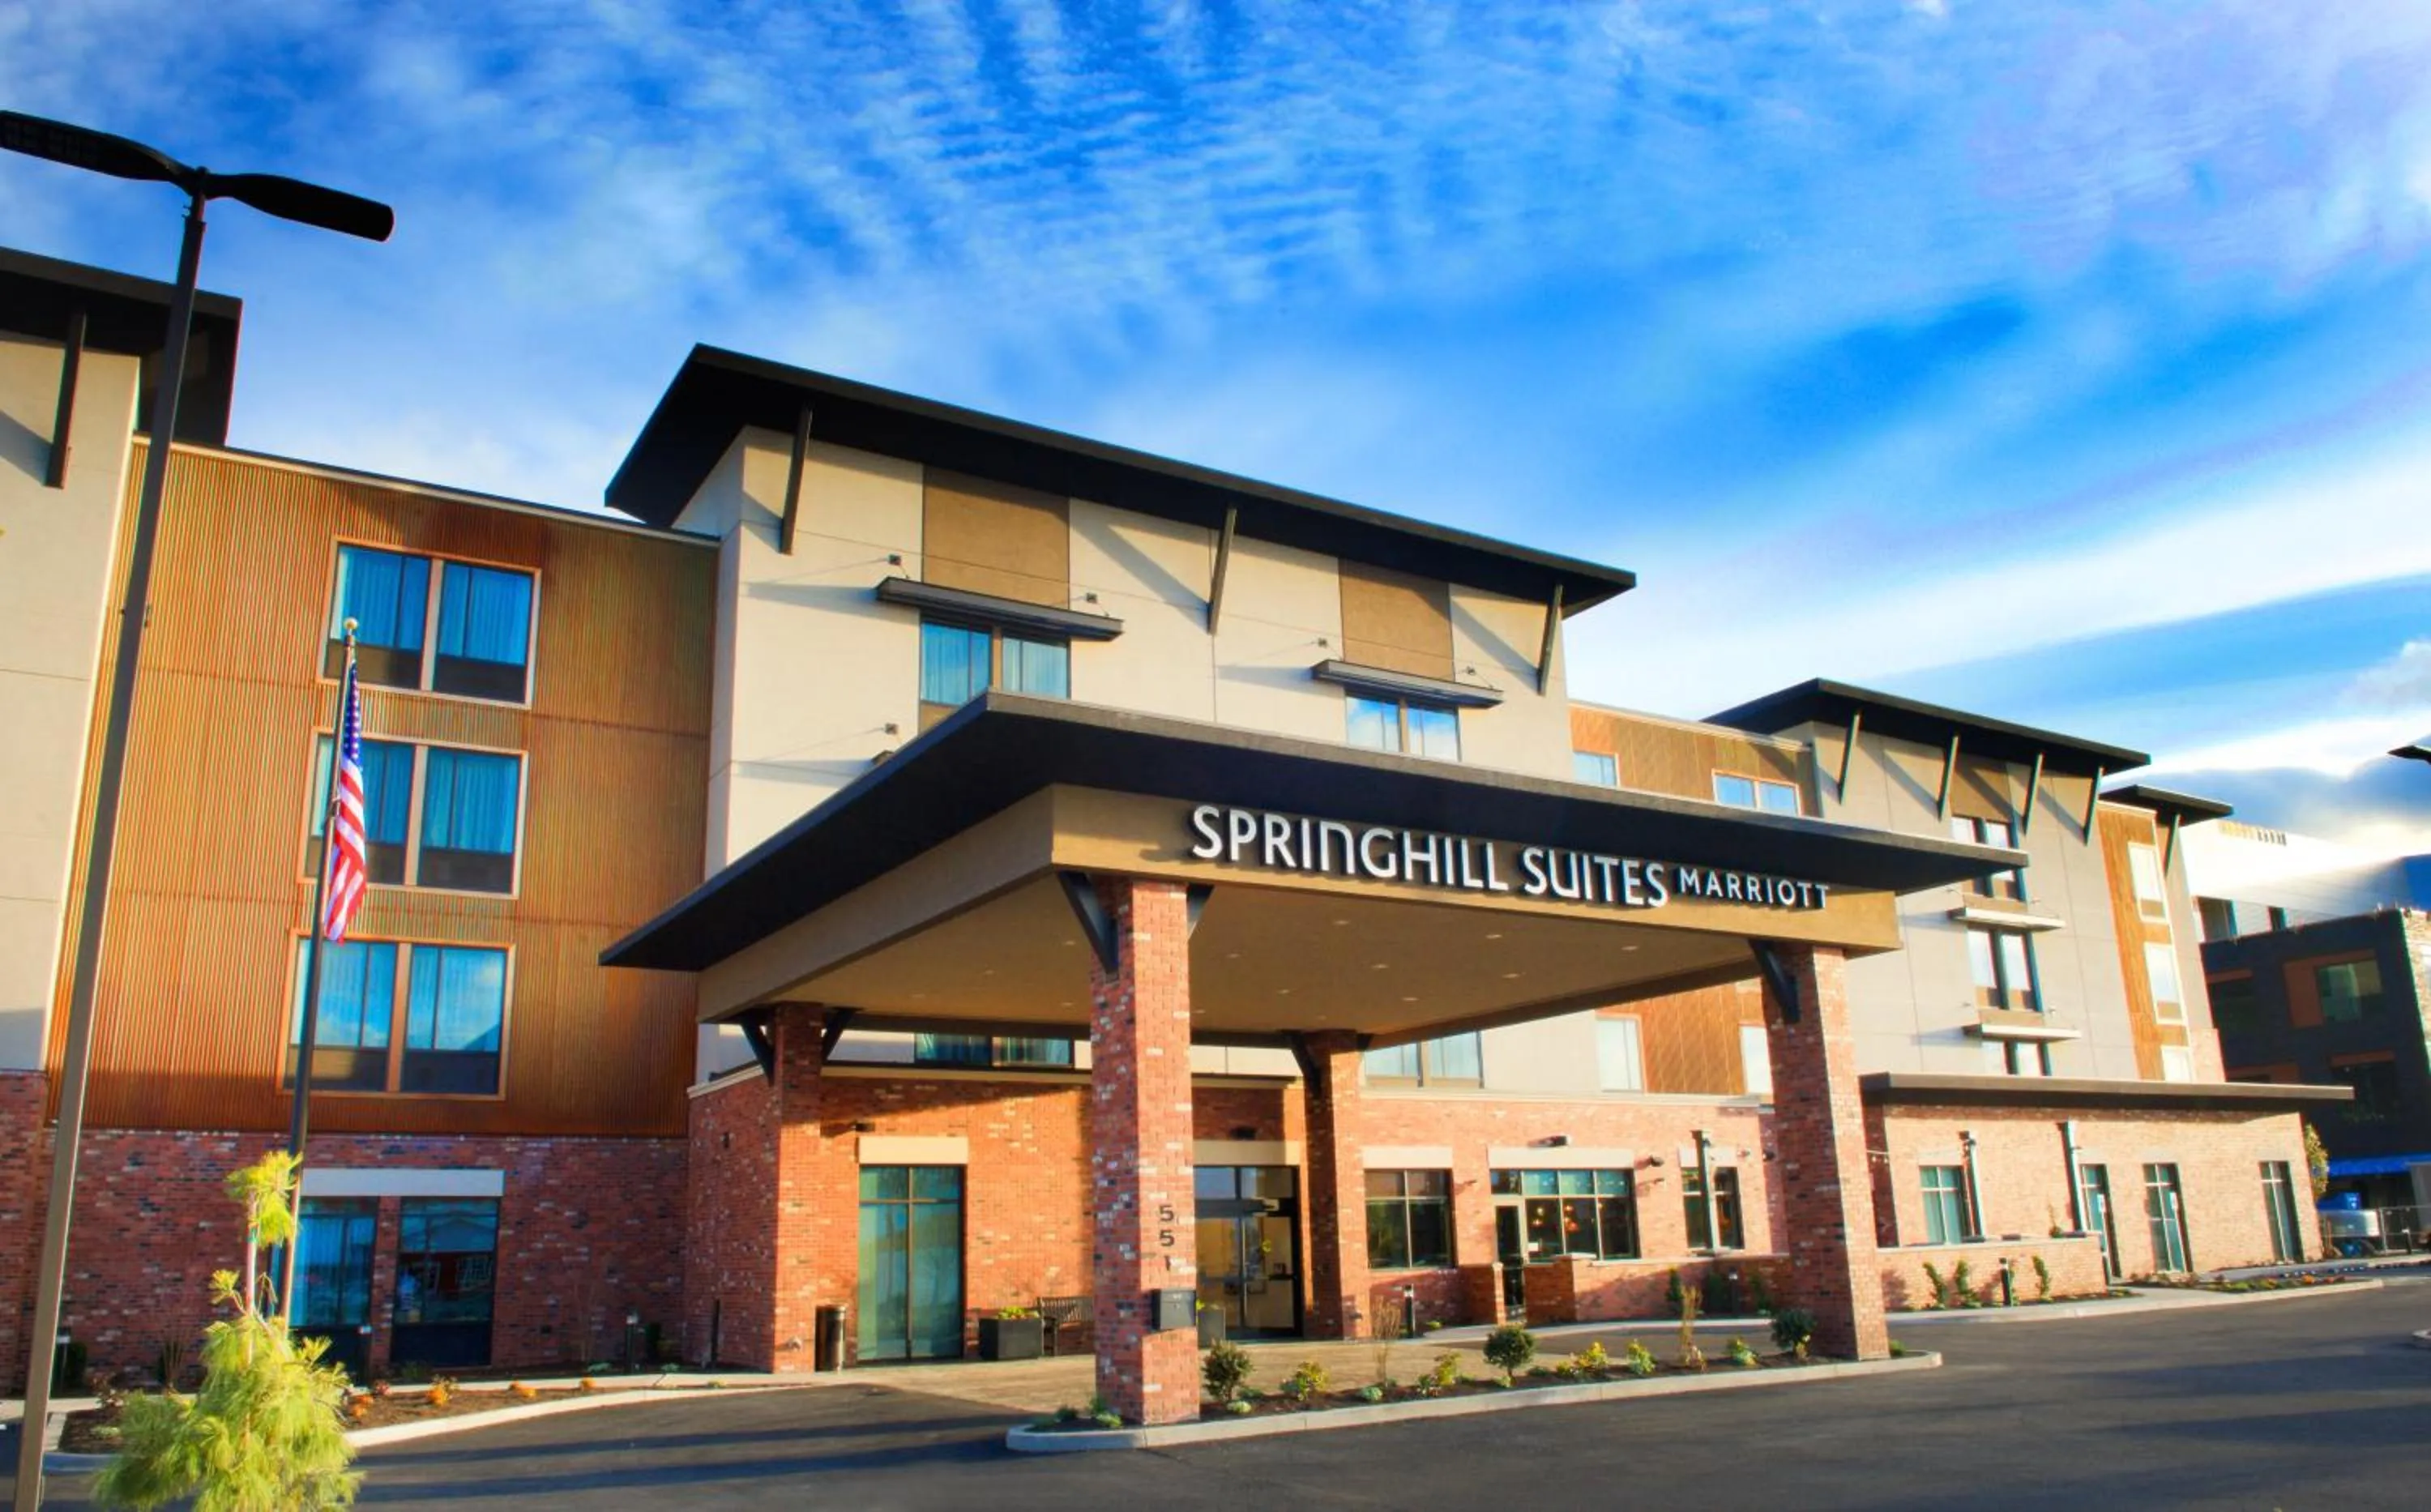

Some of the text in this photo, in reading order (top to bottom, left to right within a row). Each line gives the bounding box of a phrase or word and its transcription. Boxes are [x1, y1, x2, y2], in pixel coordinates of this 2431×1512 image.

[1192, 805, 1831, 909] SPRINGHILL SUITES MARRIOTT
